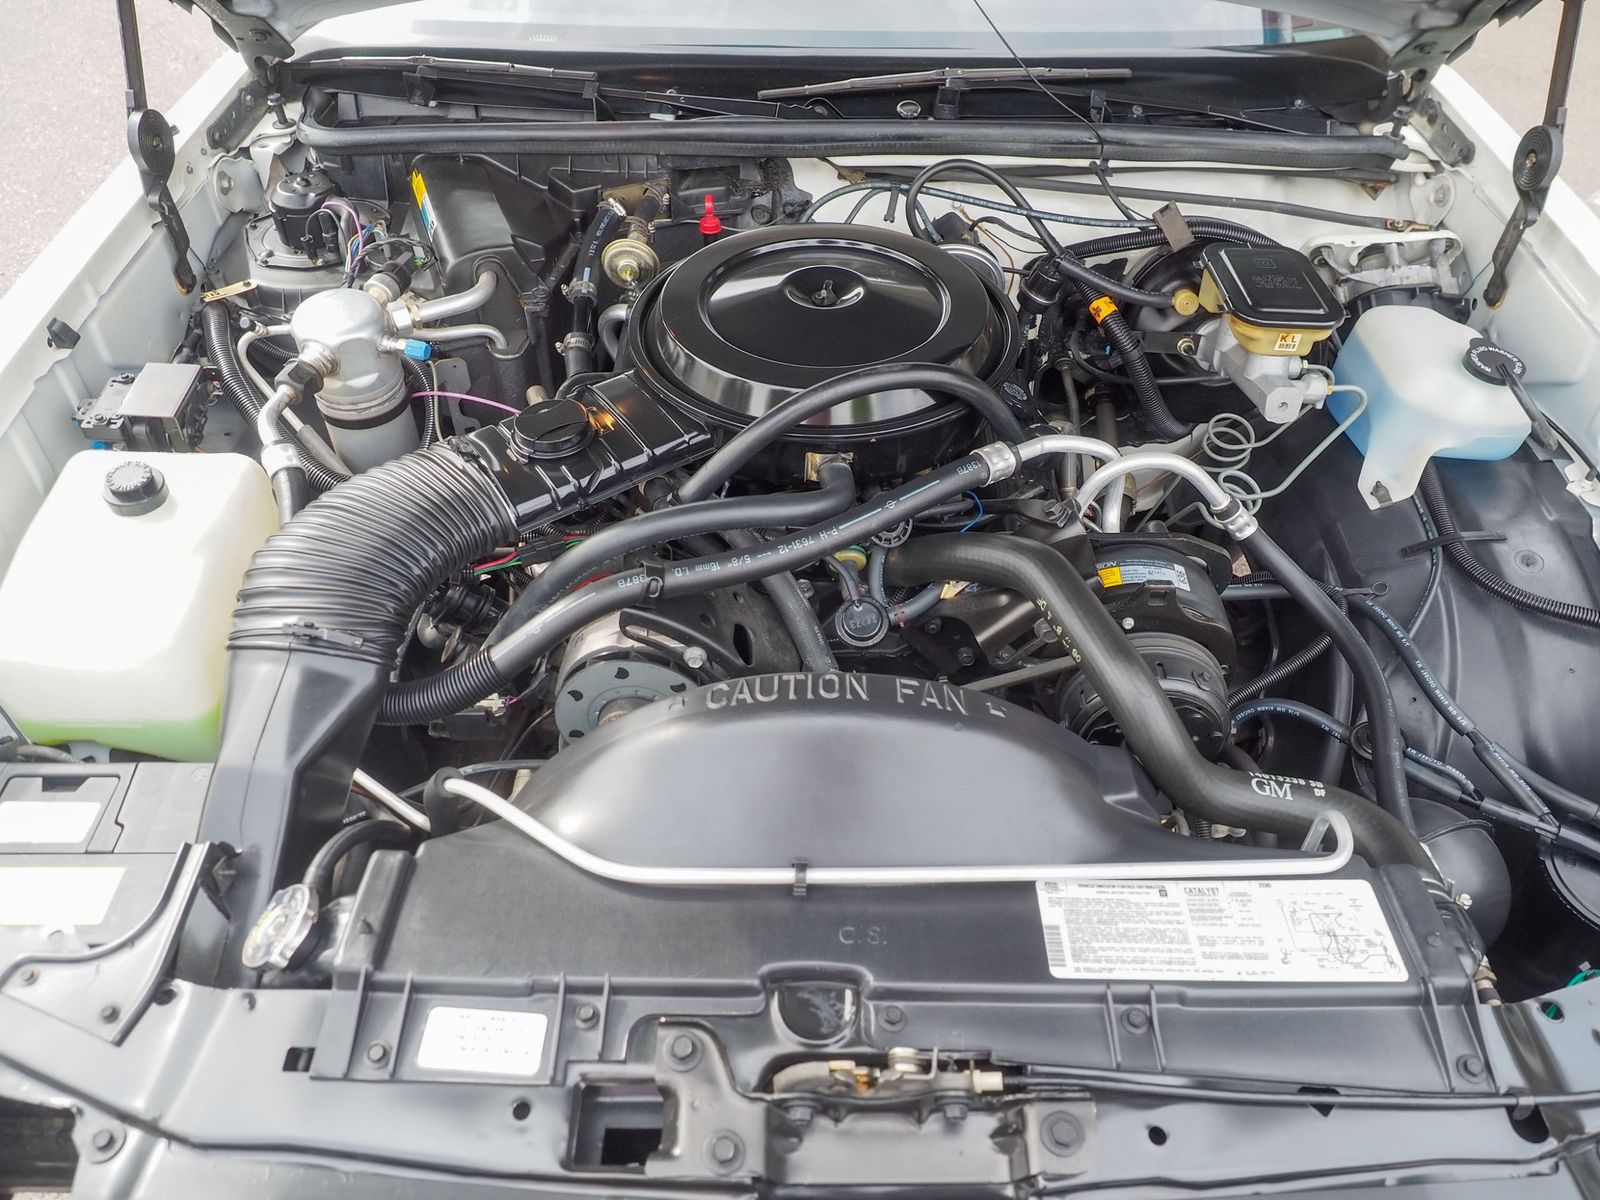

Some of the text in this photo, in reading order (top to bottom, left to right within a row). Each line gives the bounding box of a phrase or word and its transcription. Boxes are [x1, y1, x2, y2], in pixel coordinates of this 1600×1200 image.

[820, 526, 838, 539] P-H
[777, 536, 815, 554] 7631-12
[695, 560, 720, 572] 16mm
[728, 554, 751, 568] 5/8"
[706, 674, 969, 716] CAUTION FAN
[1251, 778, 1294, 800] GM
[1184, 887, 1219, 896] CATALYST
